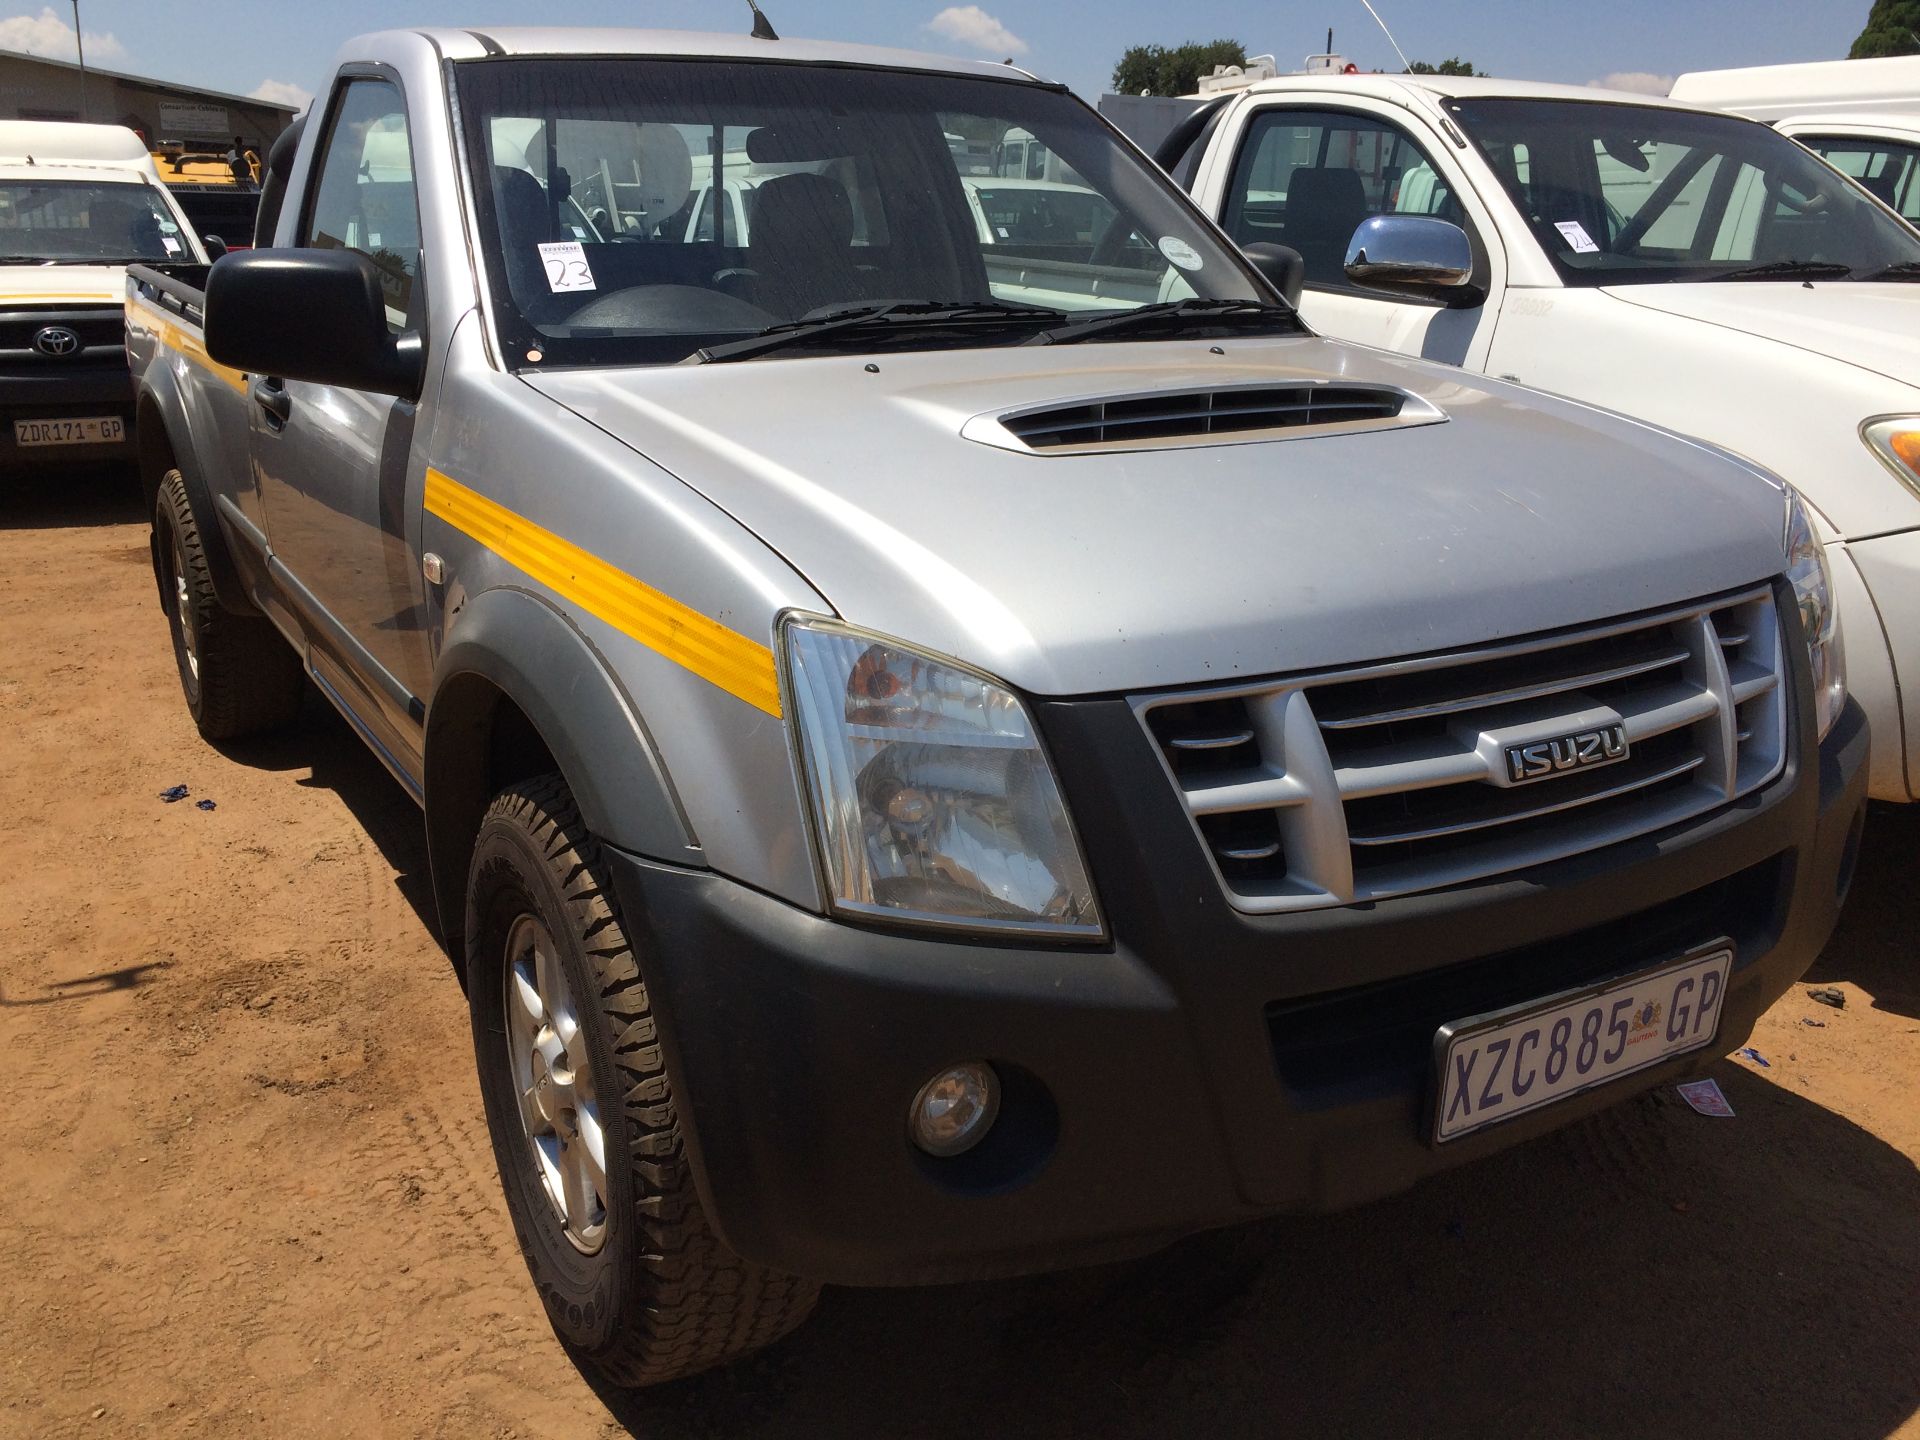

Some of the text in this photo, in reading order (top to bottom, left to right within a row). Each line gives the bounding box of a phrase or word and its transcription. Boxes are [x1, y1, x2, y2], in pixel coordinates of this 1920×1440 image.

[546, 259, 593, 287] 23
[18, 421, 121, 443] ZDR171 GP
[1510, 727, 1627, 780] ISUZU
[1447, 970, 1721, 1123] XZC885 GP
[1626, 1030, 1659, 1046] GAUTENG
